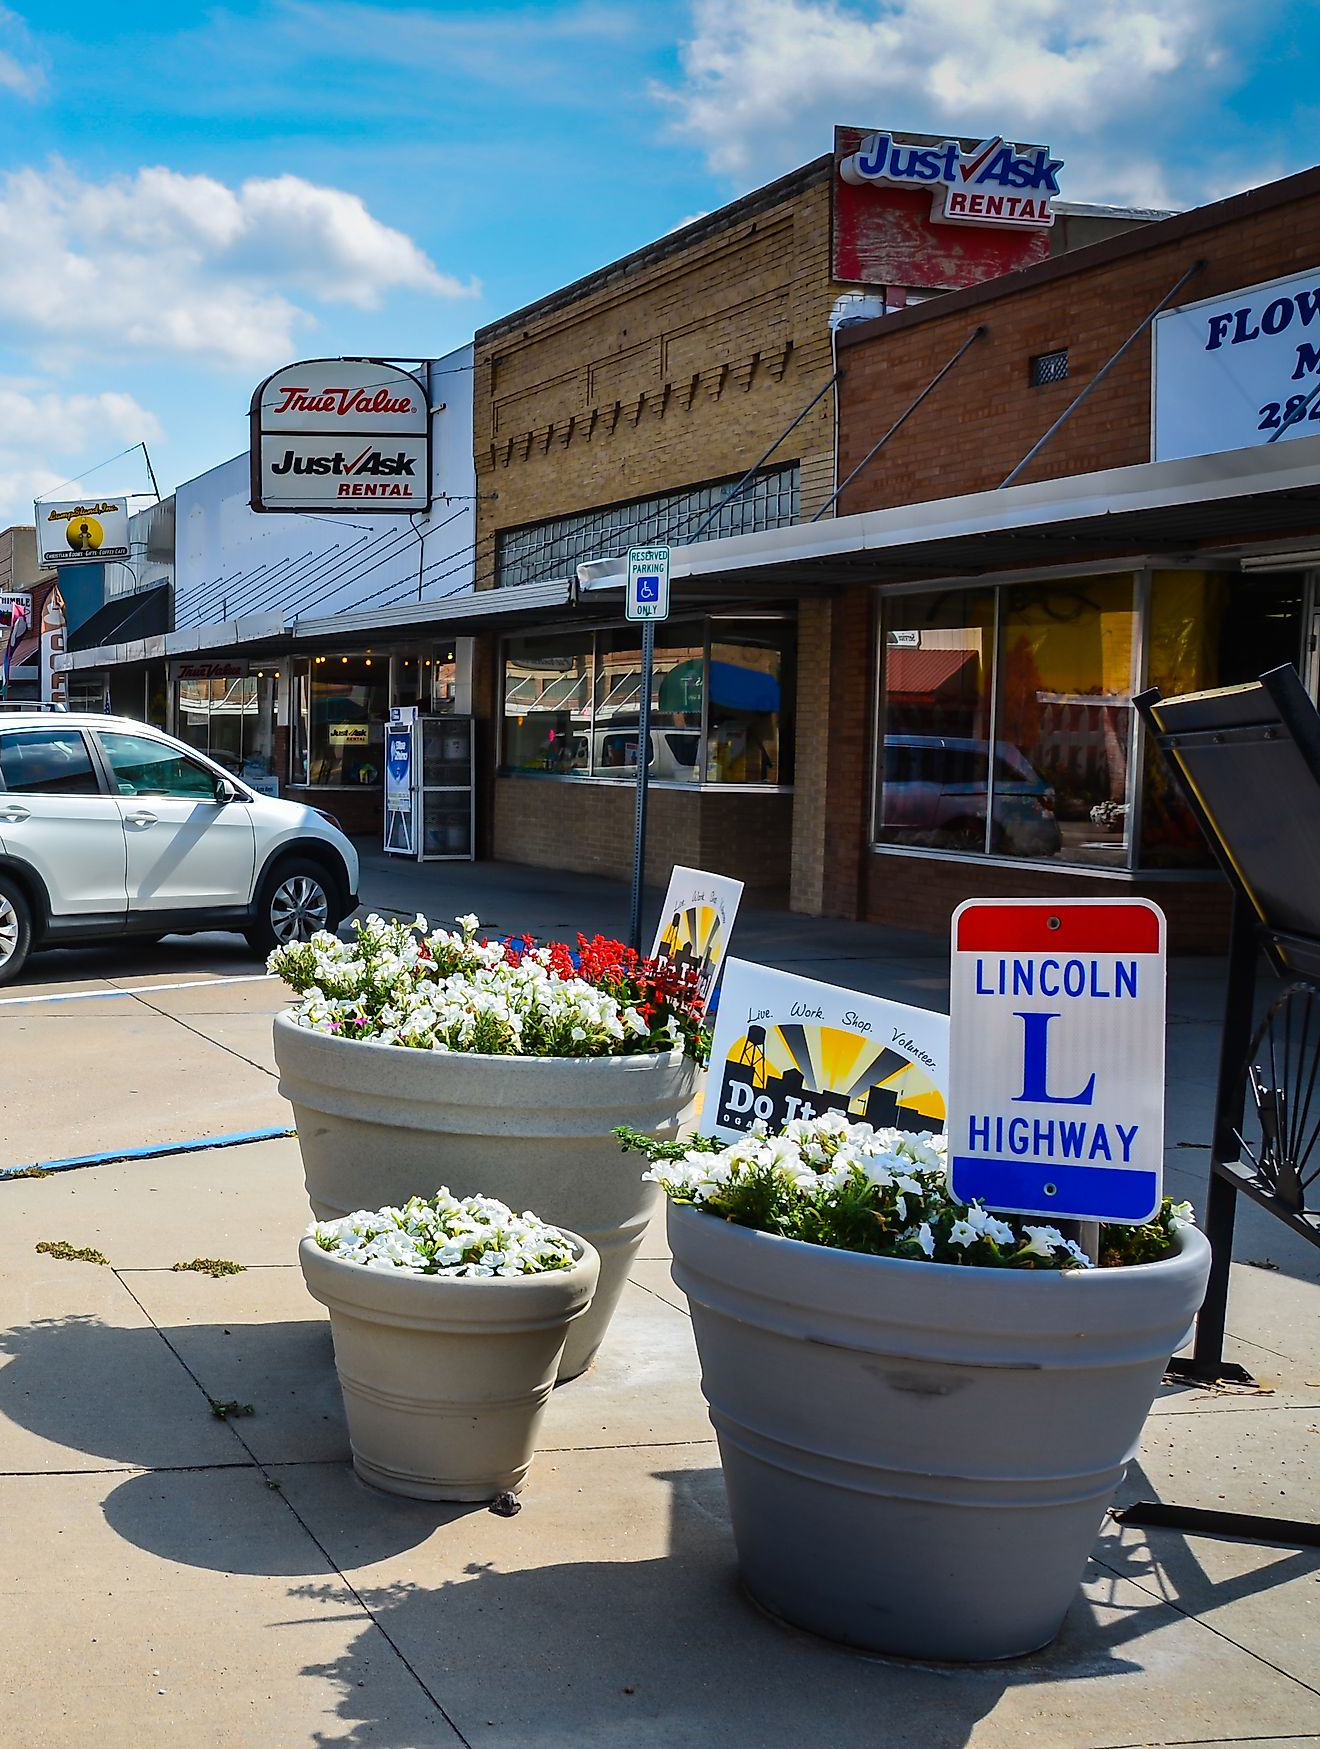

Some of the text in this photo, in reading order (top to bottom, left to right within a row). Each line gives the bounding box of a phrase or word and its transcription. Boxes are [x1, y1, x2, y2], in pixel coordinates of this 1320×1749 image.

[860, 137, 1059, 190] Just Ask
[950, 193, 1050, 219] RENTAL
[271, 451, 417, 475] Just Ask
[338, 484, 412, 496] RENTAL
[632, 551, 668, 561] RESERVED
[632, 564, 664, 573] PARKING
[637, 605, 658, 616] ONLY
[330, 729, 367, 737] Just Ask
[977, 959, 1137, 998] LINCOLN
[747, 1001, 937, 1071] Live. Work. Shop. Volunteer.
[1011, 1012, 1096, 1106] L
[725, 1079, 817, 1126] Do It
[969, 1115, 1139, 1163] HIGHWAY
